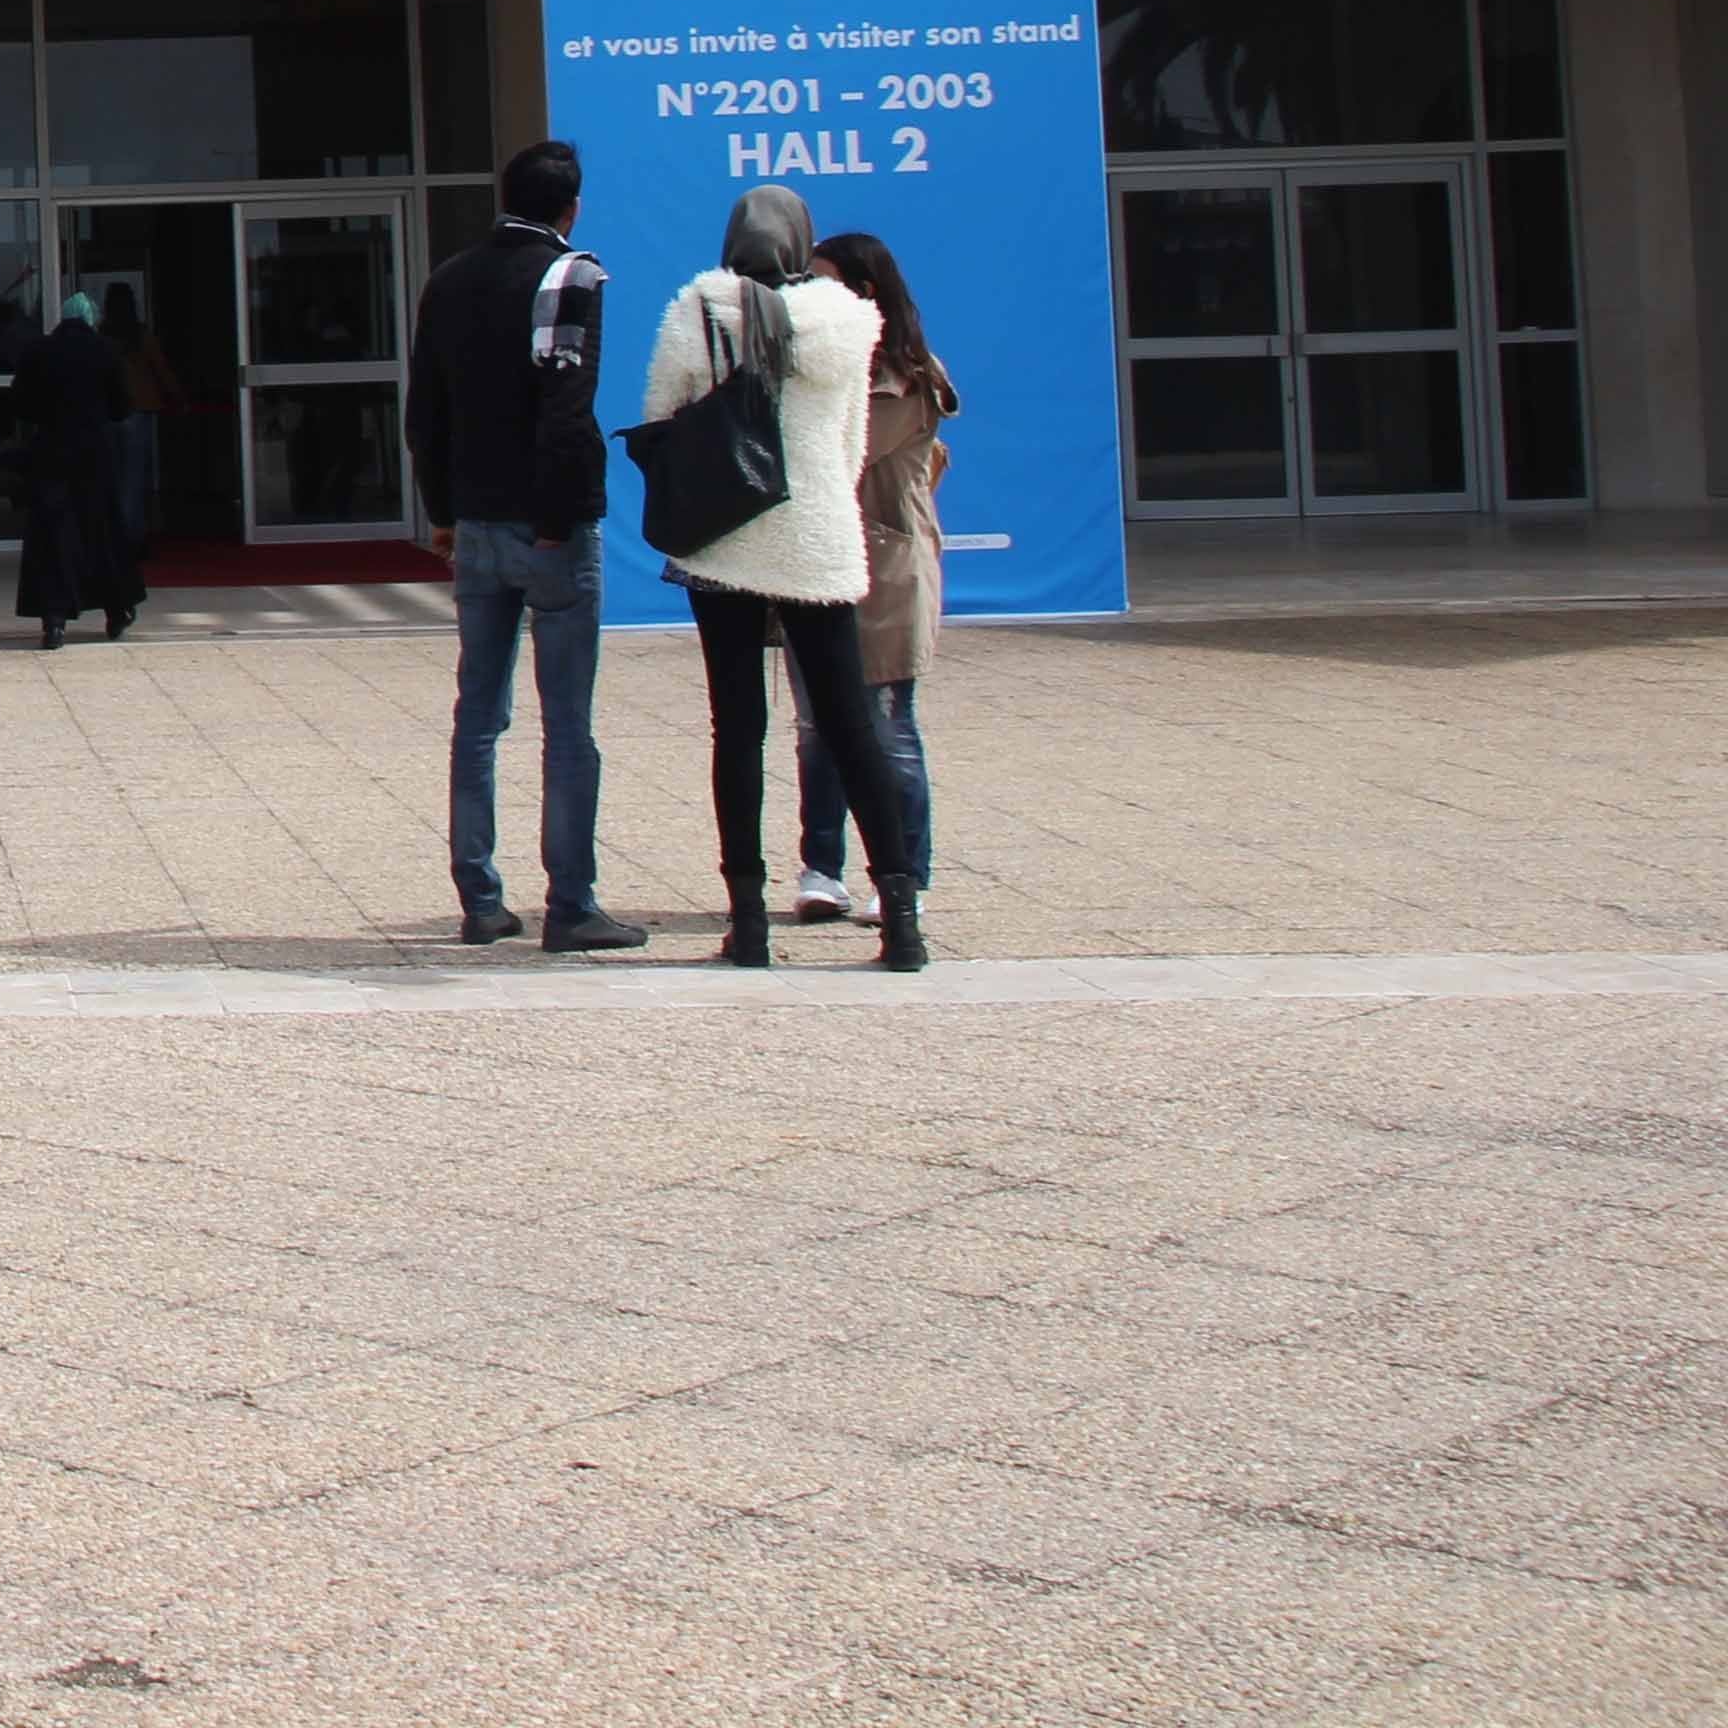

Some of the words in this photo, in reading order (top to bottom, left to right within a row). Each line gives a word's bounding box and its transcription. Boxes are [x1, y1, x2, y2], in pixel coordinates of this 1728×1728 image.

[563, 36, 593, 59] et
[602, 32, 678, 57] vous
[689, 26, 777, 54] invite
[786, 23, 808, 51] à
[816, 22, 914, 50] visiter
[925, 22, 982, 47] son
[992, 14, 1080, 43] stand
[656, 78, 821, 118] N°2201
[877, 72, 993, 111] 2003
[728, 130, 873, 177] HALL
[891, 126, 929, 172] 2
